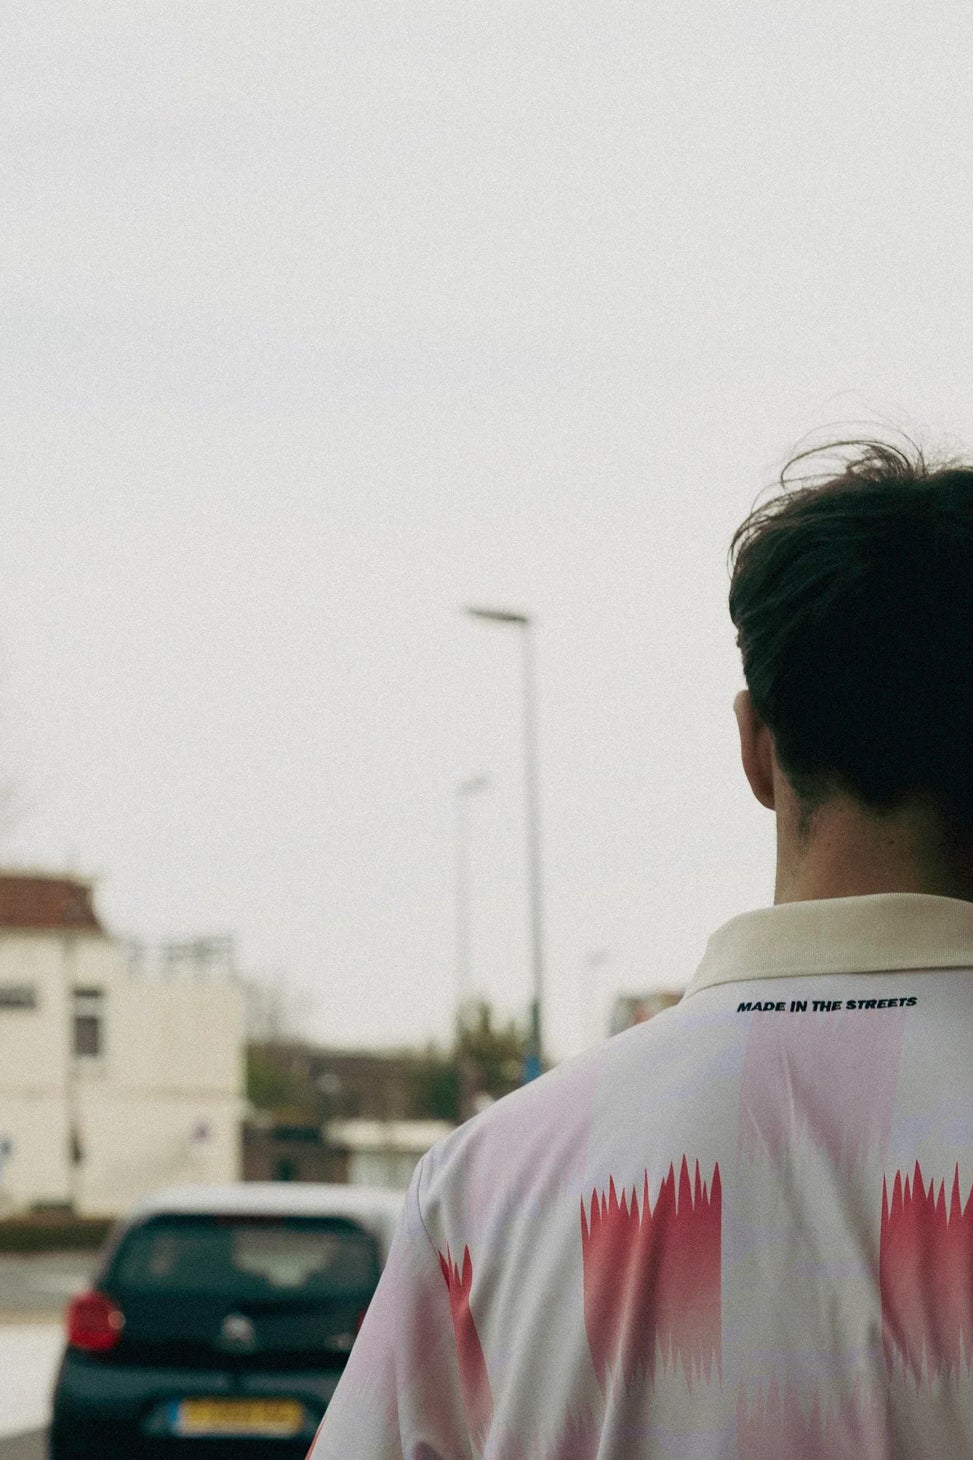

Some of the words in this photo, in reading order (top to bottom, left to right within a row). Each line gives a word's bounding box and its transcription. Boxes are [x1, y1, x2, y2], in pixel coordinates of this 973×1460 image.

[736, 1001, 786, 1012] MADE
[790, 1001, 808, 1012] IN
[812, 1000, 843, 1012] THE
[845, 997, 918, 1010] STREETS
